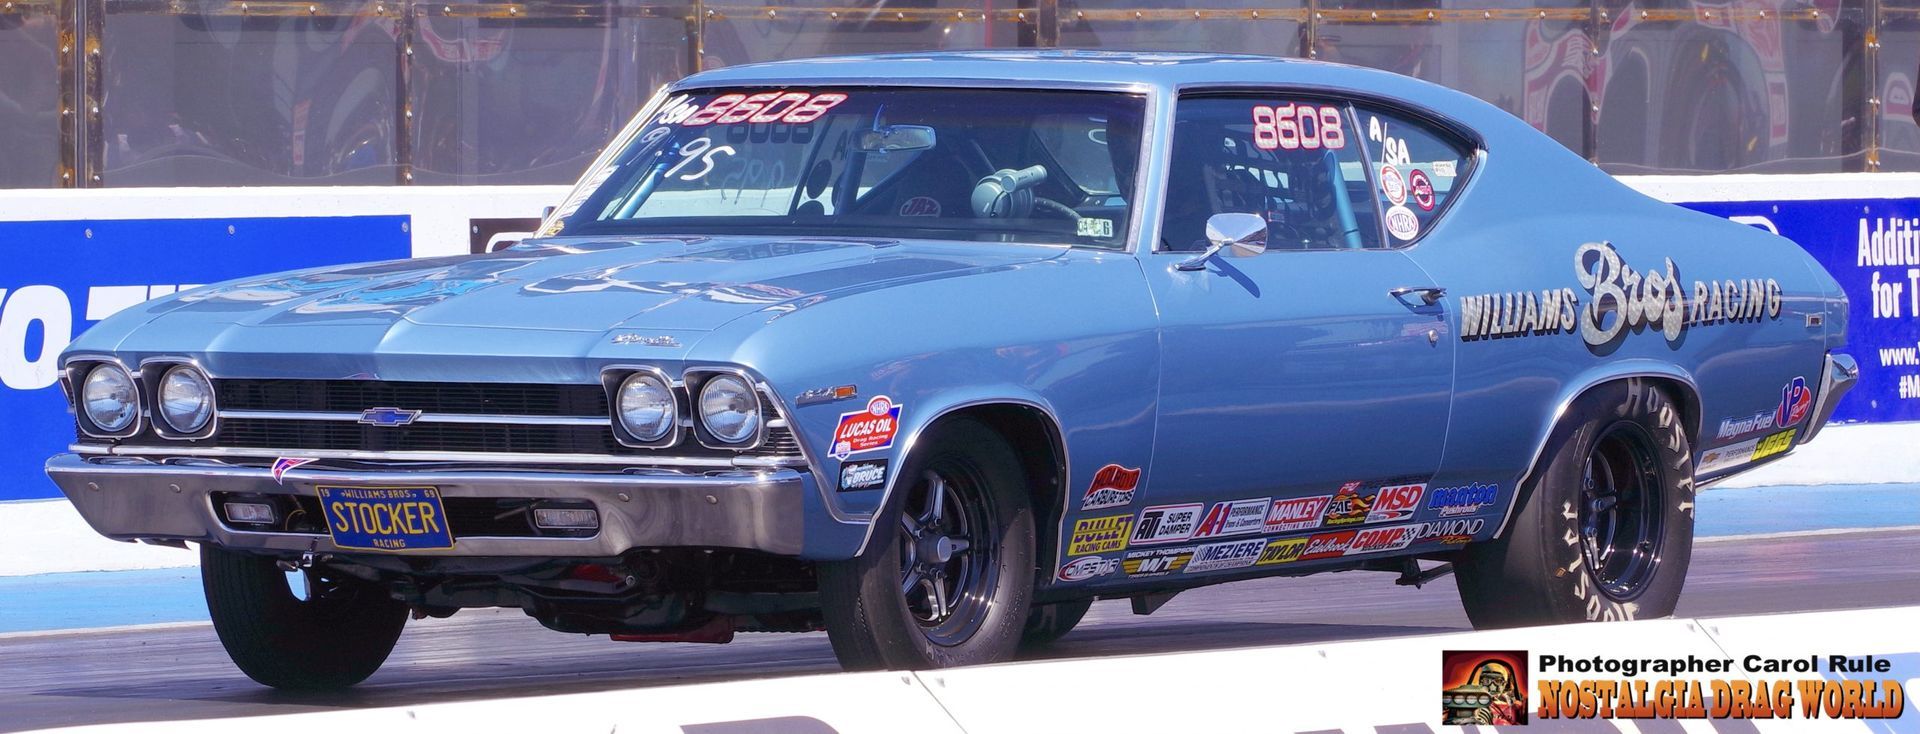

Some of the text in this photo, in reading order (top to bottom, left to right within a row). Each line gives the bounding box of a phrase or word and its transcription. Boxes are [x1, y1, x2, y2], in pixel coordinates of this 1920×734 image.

[683, 91, 848, 127] 8608
[1252, 102, 1346, 151] 8608
[1390, 213, 1416, 233] NHRA
[1857, 217, 1920, 268] Additi
[1459, 240, 1783, 350] WILLIAMS Bros RACING
[1871, 270, 1903, 319] for
[1781, 375, 1806, 428] VP
[840, 417, 893, 439] LUCAS OIL
[1716, 410, 1777, 440] MagnaFuel
[320, 488, 331, 498] 19
[344, 488, 386, 499] WILLIAMS
[423, 488, 436, 498] 69
[1372, 485, 1423, 512] MSD
[1428, 482, 1498, 511] manton
[331, 501, 440, 535] STOCKER
[1167, 511, 1193, 524] SUPER
[1230, 504, 1265, 517] PERFORMANCE
[1267, 499, 1323, 522] MANLEY
[1073, 516, 1134, 544] BULLET
[1158, 523, 1192, 536] DAMPER
[1351, 527, 1406, 549] COMP
[1416, 518, 1485, 539] DIAMOND
[373, 538, 406, 549] RACING
[1074, 539, 1123, 553] RACING CAMS
[1127, 546, 1198, 559] MICKEY THOMPSON
[1203, 540, 1265, 561] MEZIERE
[1261, 542, 1305, 561] TAYLOR
[1303, 536, 1355, 555] Edelbrock
